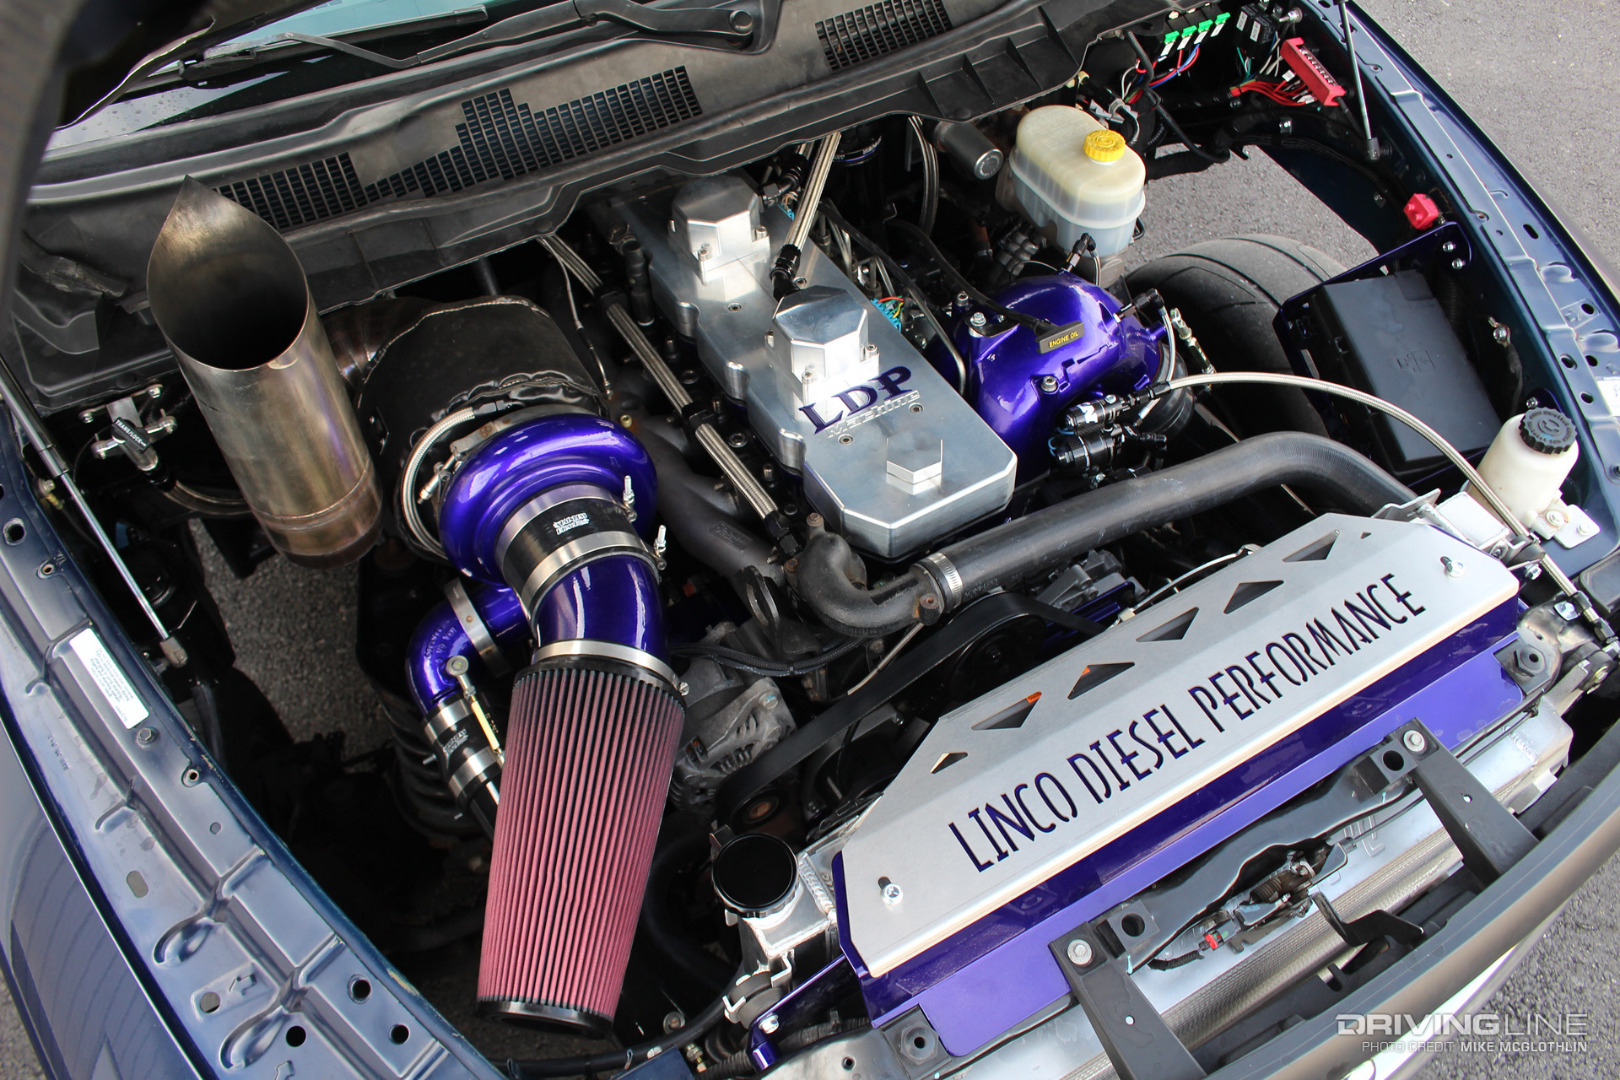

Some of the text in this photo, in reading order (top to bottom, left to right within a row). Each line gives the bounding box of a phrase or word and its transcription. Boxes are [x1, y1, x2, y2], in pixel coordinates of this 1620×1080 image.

[1049, 331, 1079, 348] ENGINE OIL
[798, 366, 913, 434] LDP
[948, 573, 1426, 873] LINCO DIESEL PERFORMANCE
